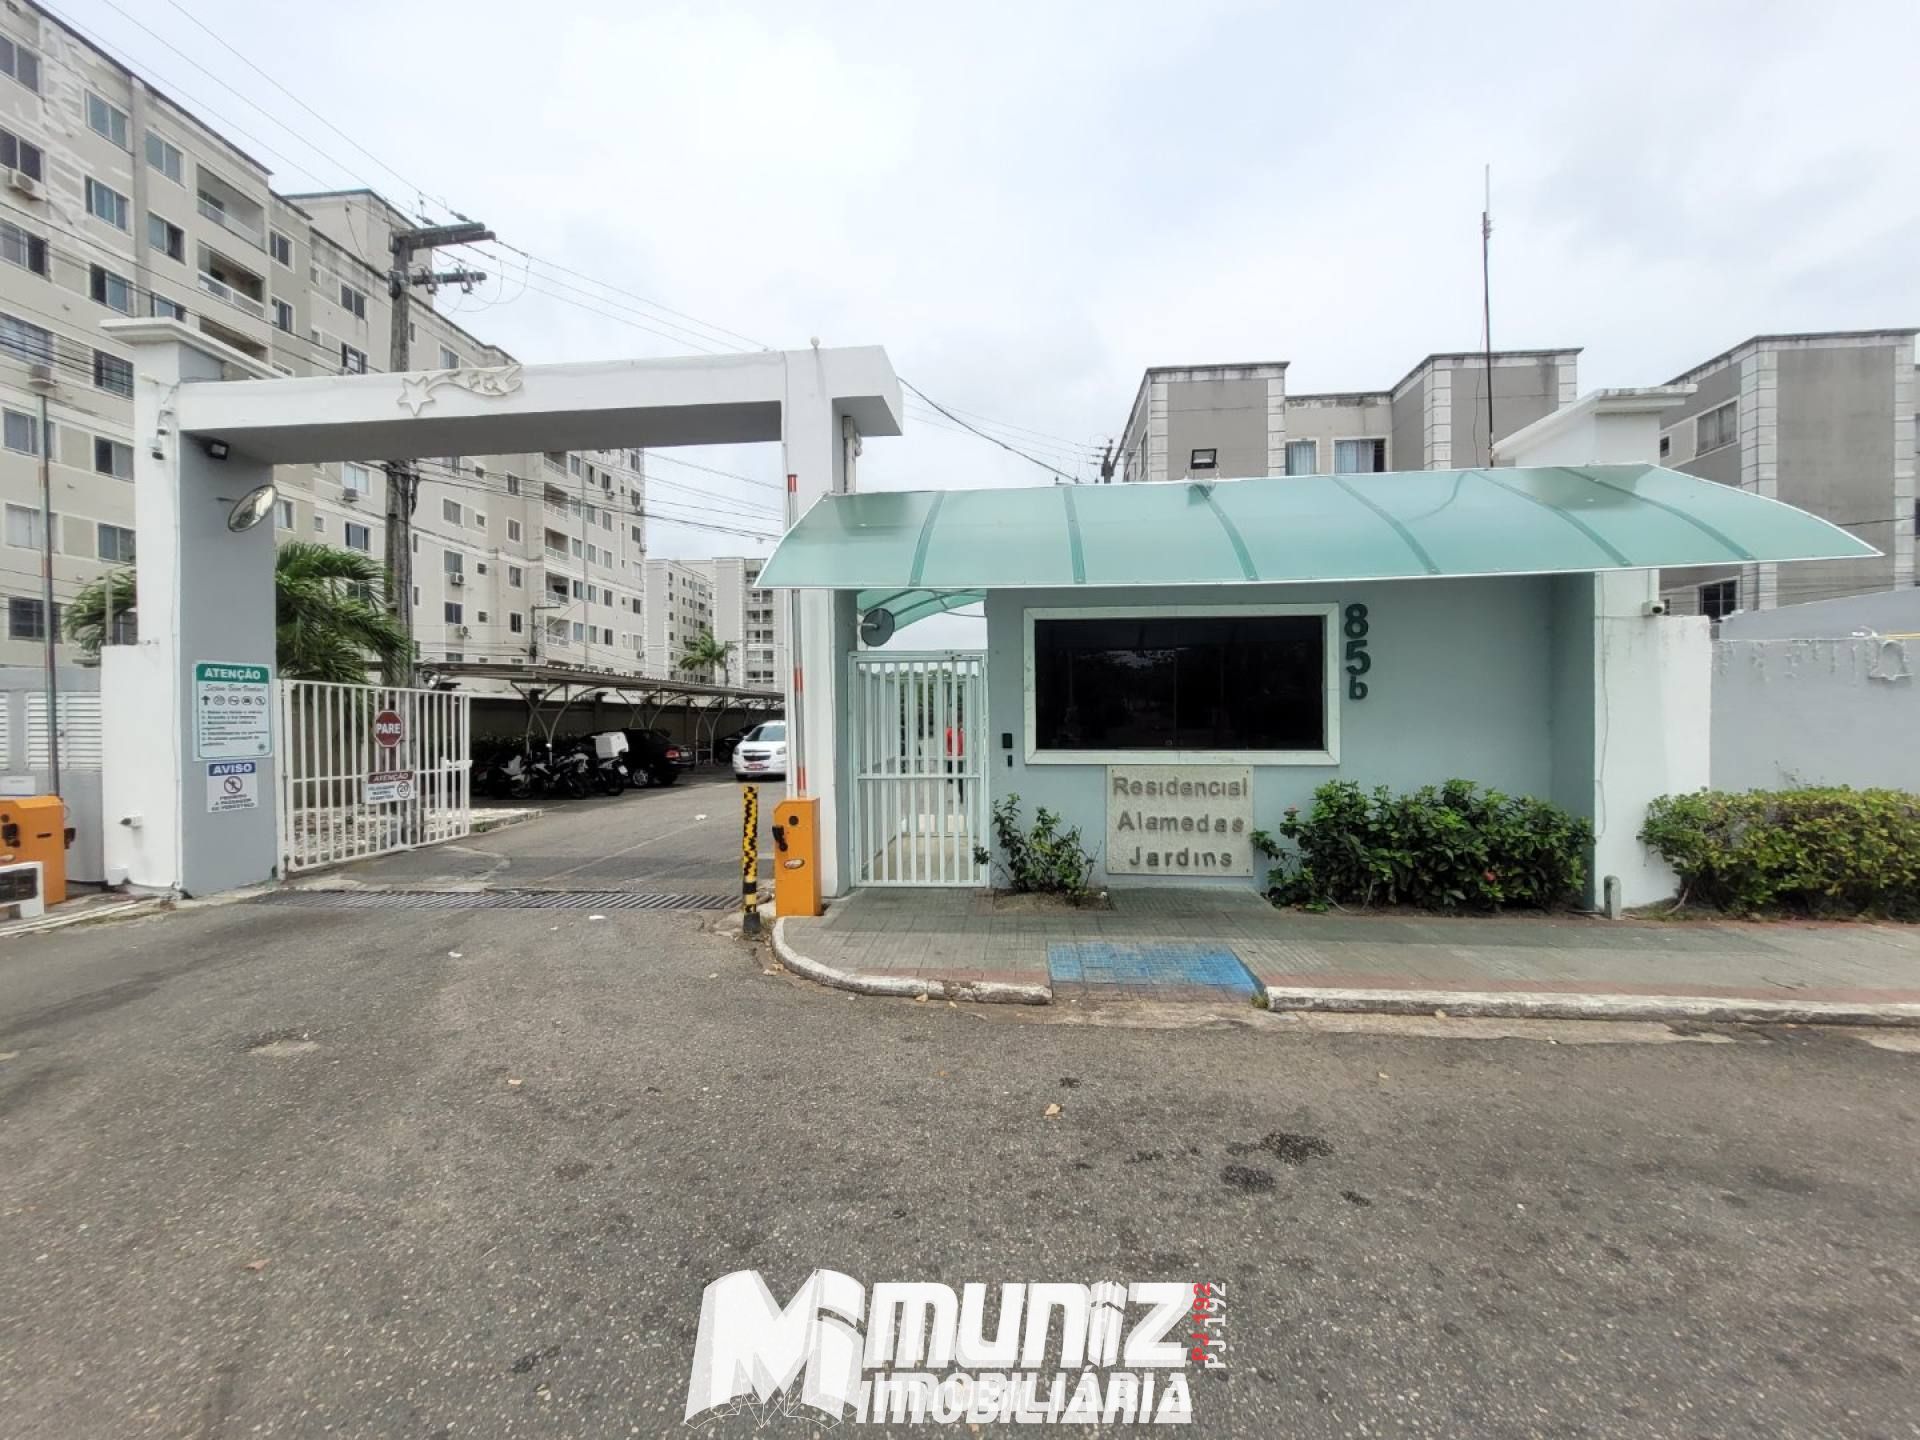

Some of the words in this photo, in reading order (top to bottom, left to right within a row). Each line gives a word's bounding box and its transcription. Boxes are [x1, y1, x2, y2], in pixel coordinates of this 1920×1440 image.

[204, 667, 261, 680] ATENÇÃO
[376, 723, 401, 734] PARE
[213, 763, 253, 774] AVISO
[1112, 776, 1247, 797] Residencial
[1117, 810, 1245, 834] Alamedas
[1129, 846, 1232, 867] Jardins
